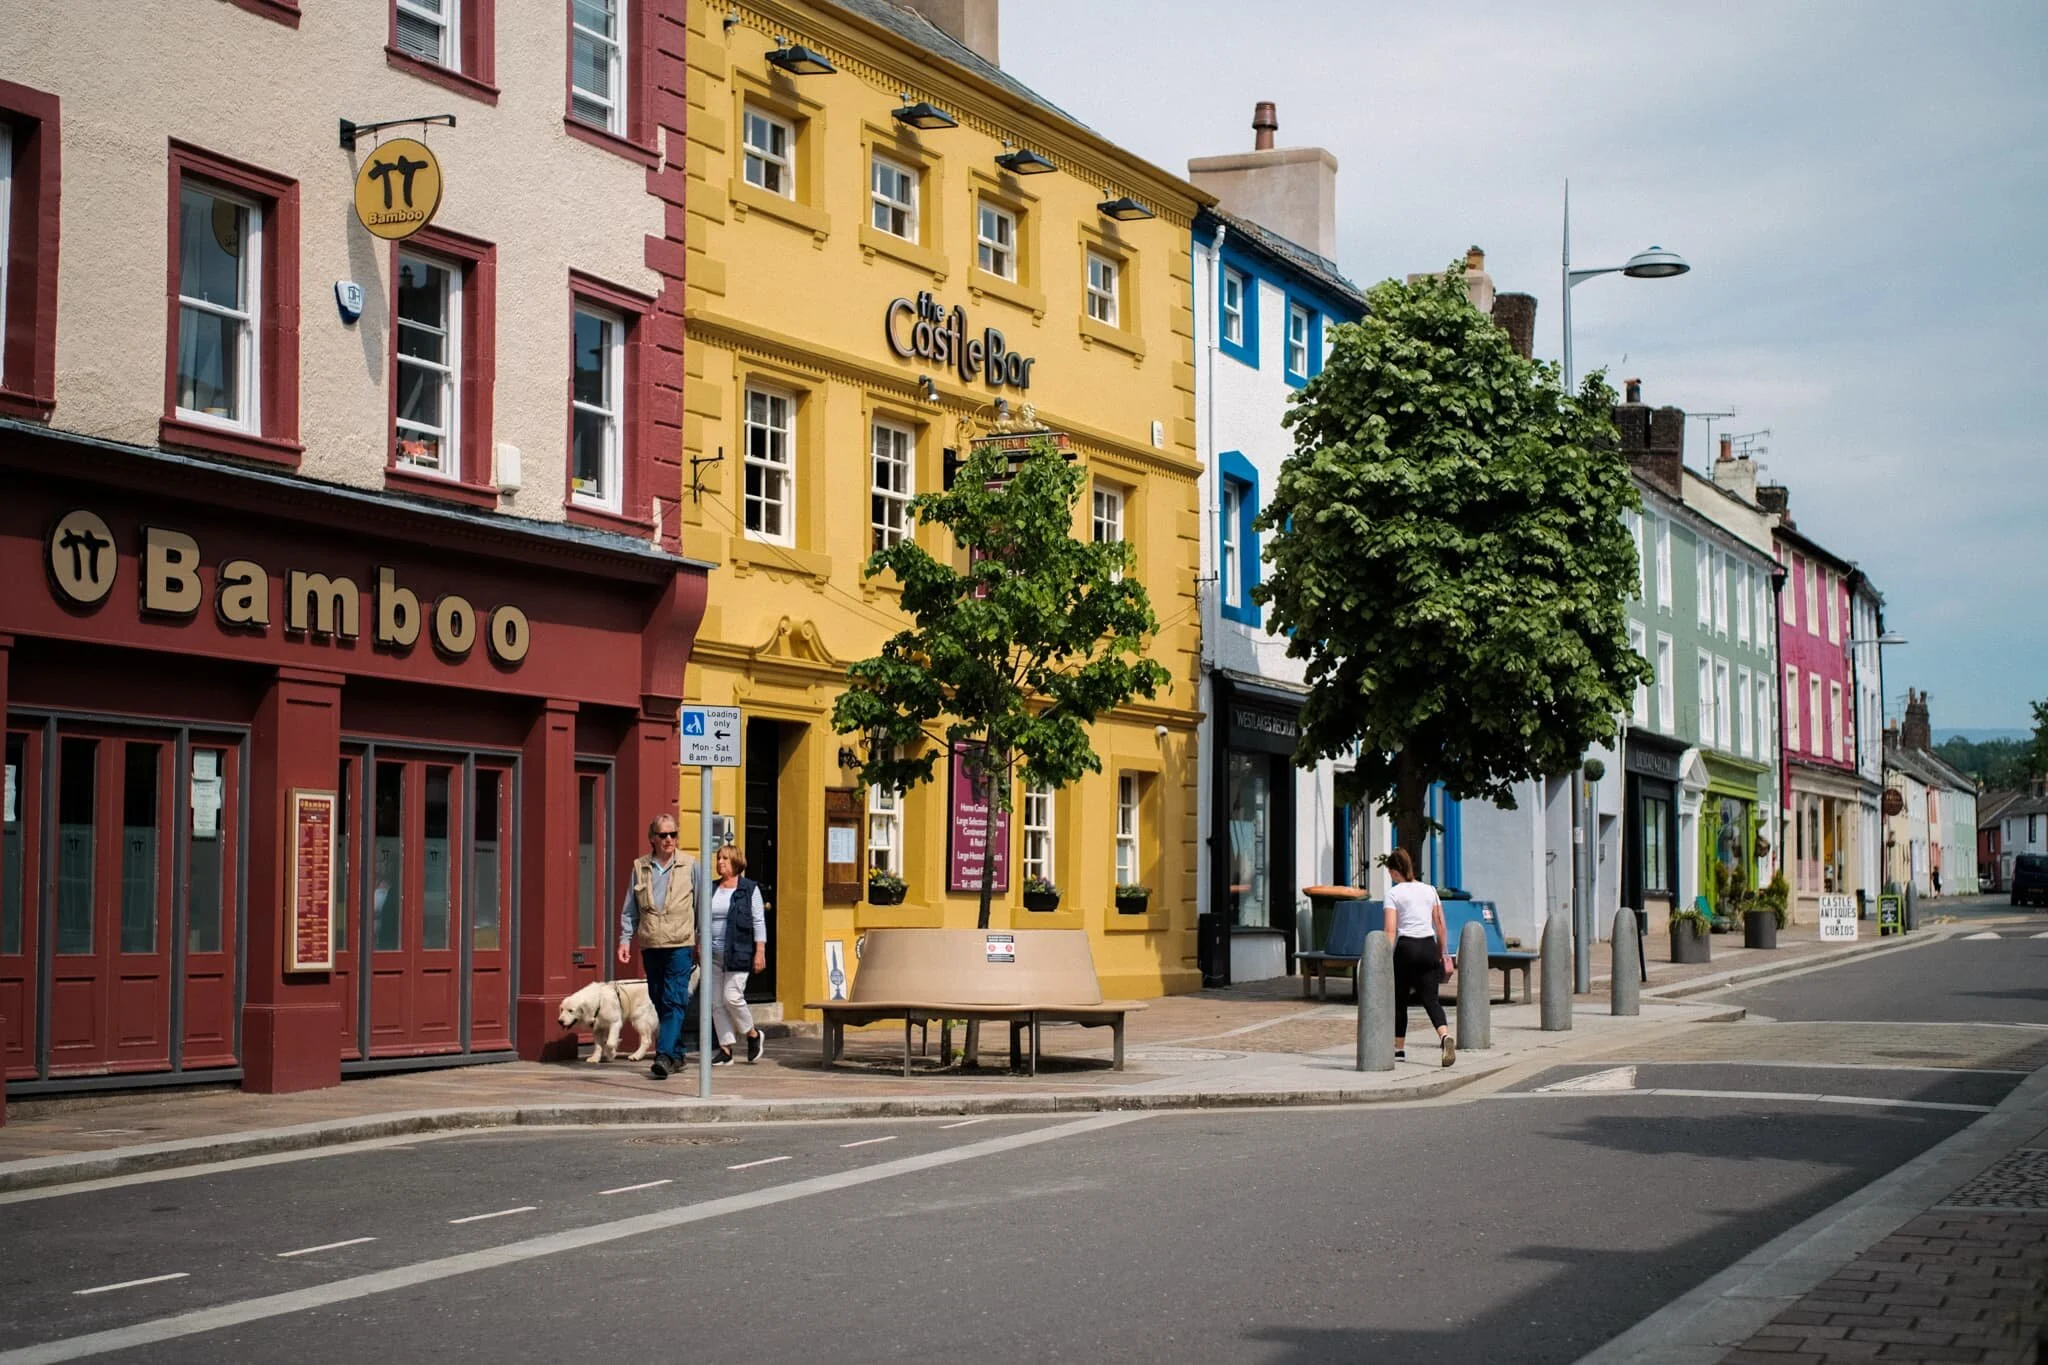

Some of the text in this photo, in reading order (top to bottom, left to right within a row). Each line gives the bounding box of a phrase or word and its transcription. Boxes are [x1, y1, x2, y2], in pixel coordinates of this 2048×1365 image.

[368, 209, 425, 225] Bamboo
[918, 291, 945, 322] the
[885, 297, 1036, 388] Castle Bar
[142, 525, 530, 665] Bamboo
[707, 709, 738, 719] Loading
[713, 719, 731, 728] only
[692, 743, 709, 751] Mon
[1821, 896, 1852, 907] CASTLE
[1820, 907, 1857, 918] ANTIQUES
[1825, 925, 1855, 936] CURIOS
